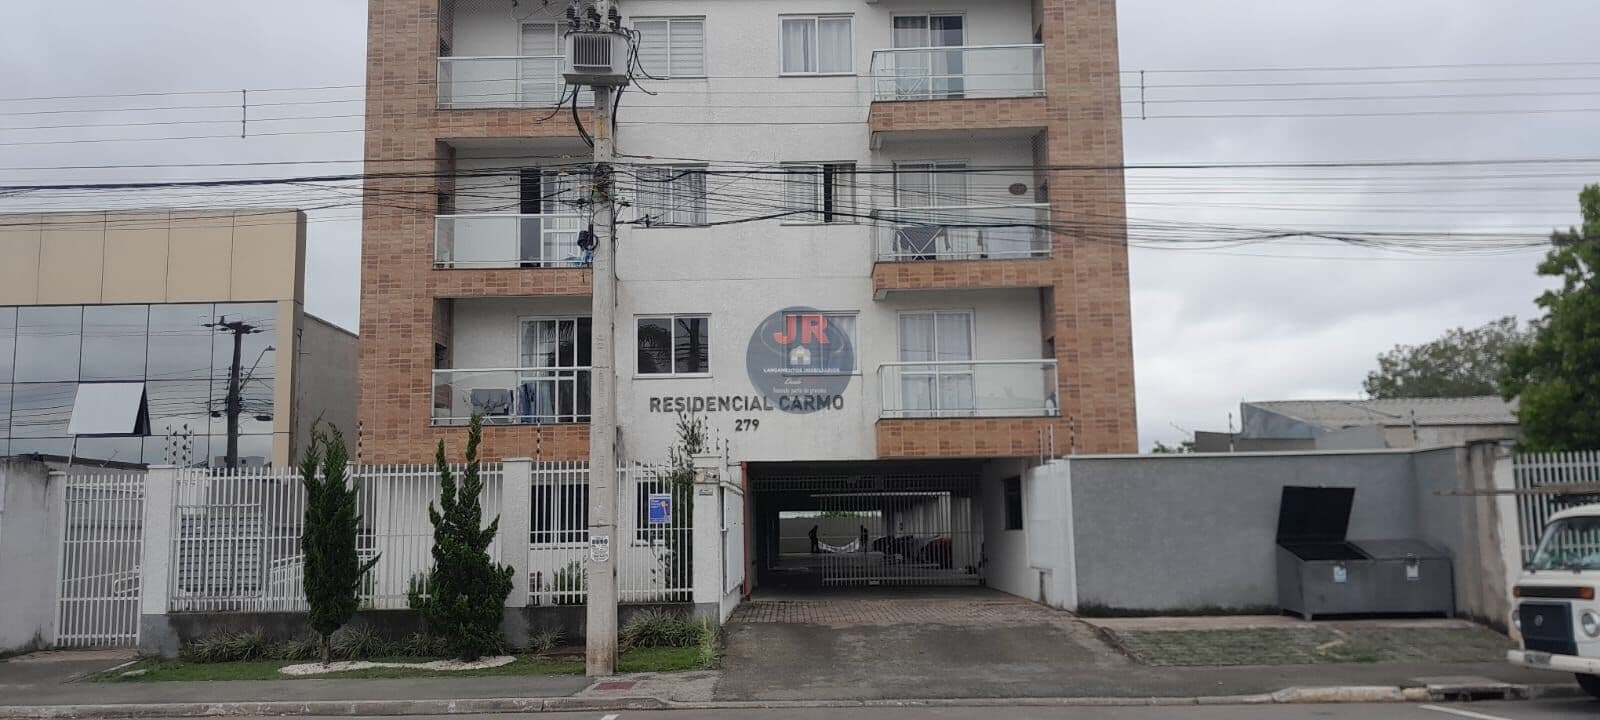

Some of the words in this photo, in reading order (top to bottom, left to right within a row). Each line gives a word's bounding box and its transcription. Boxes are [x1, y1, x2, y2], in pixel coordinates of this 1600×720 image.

[649, 395, 774, 413] RESIDENCIAL
[779, 394, 844, 412] CARMO
[735, 419, 759, 432] 279
